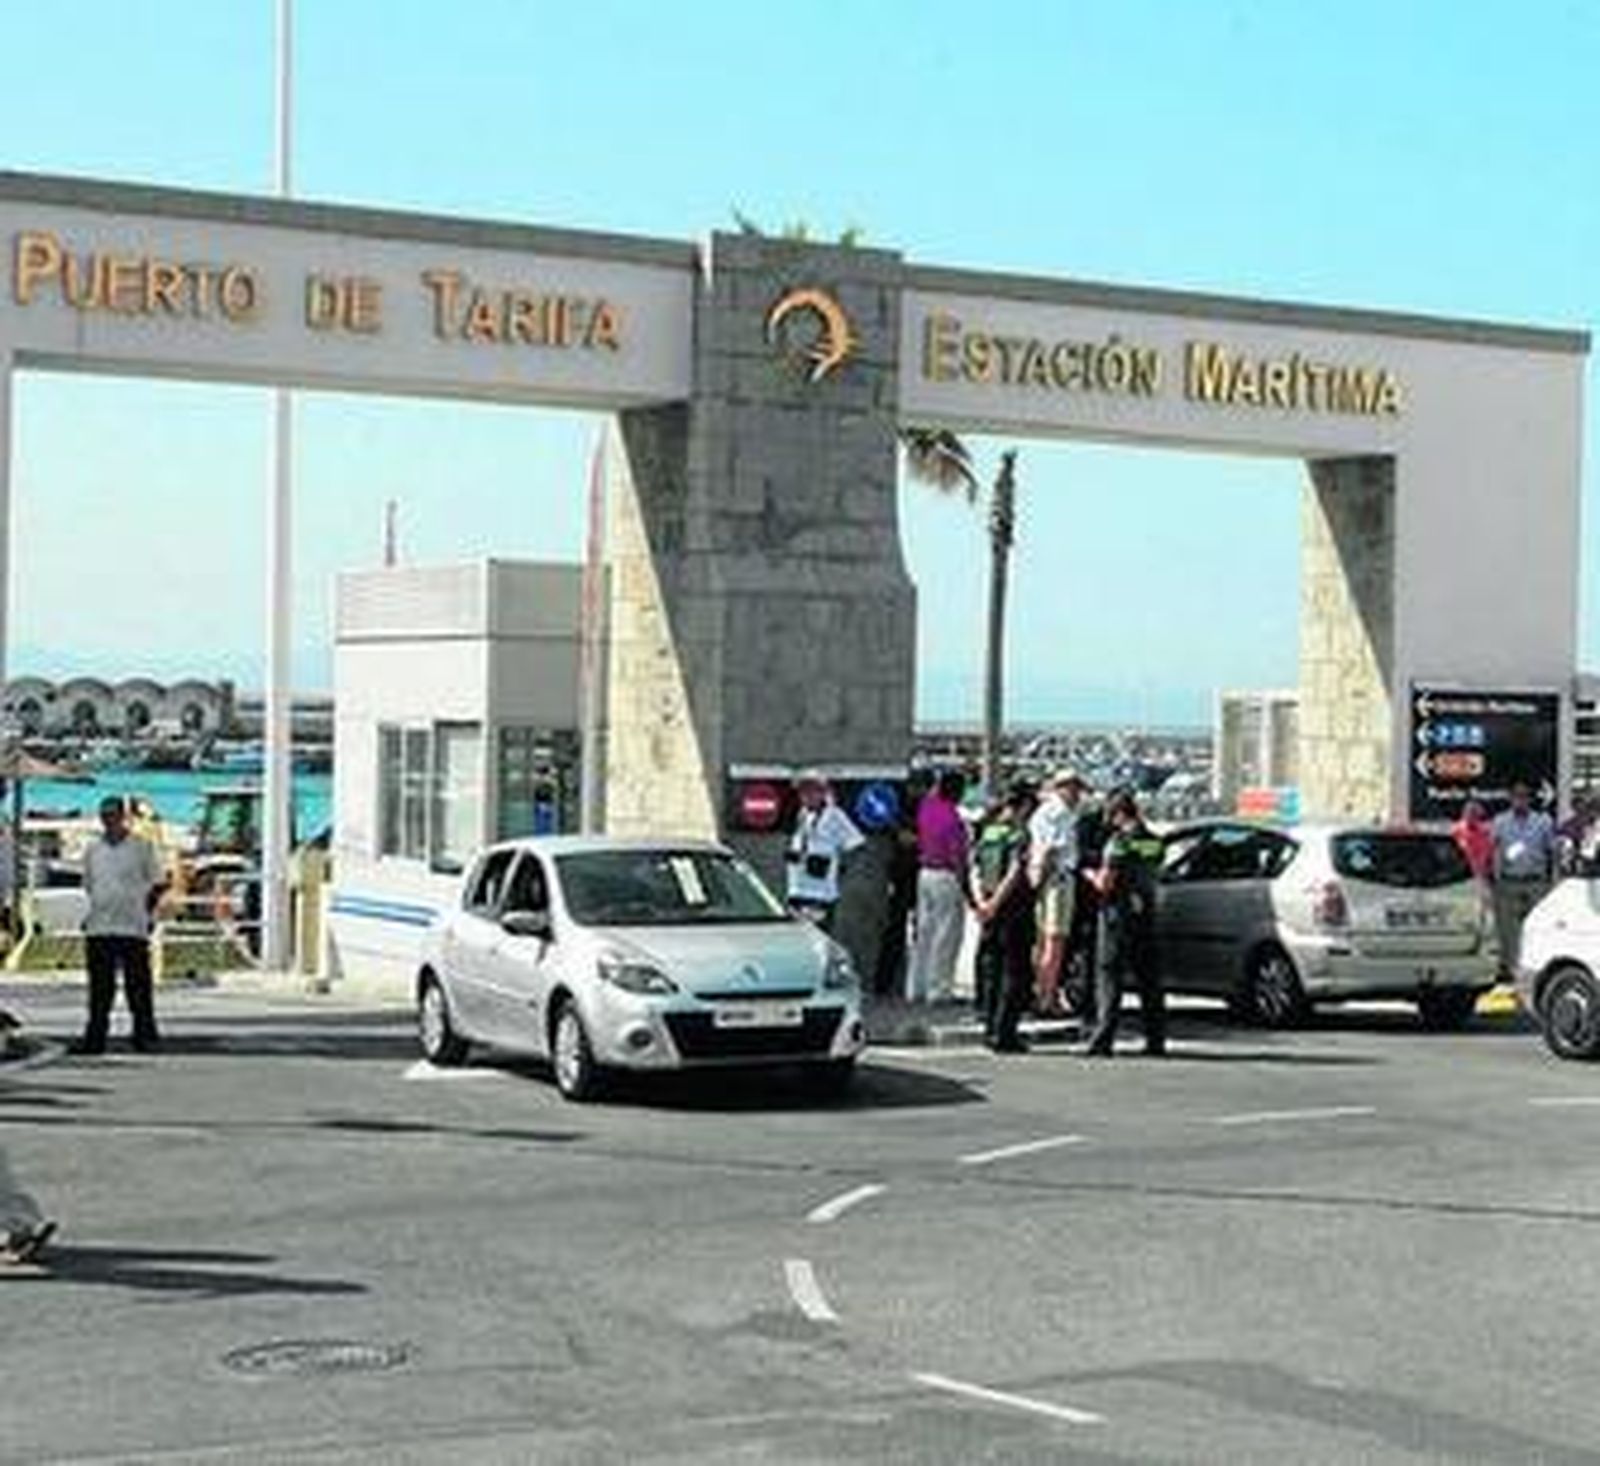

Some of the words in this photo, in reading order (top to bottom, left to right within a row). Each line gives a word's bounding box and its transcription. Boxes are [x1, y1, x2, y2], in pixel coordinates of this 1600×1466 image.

[13, 230, 259, 322] PUERTO
[304, 273, 383, 334] DE
[922, 308, 1159, 396] ESTACIÓN
